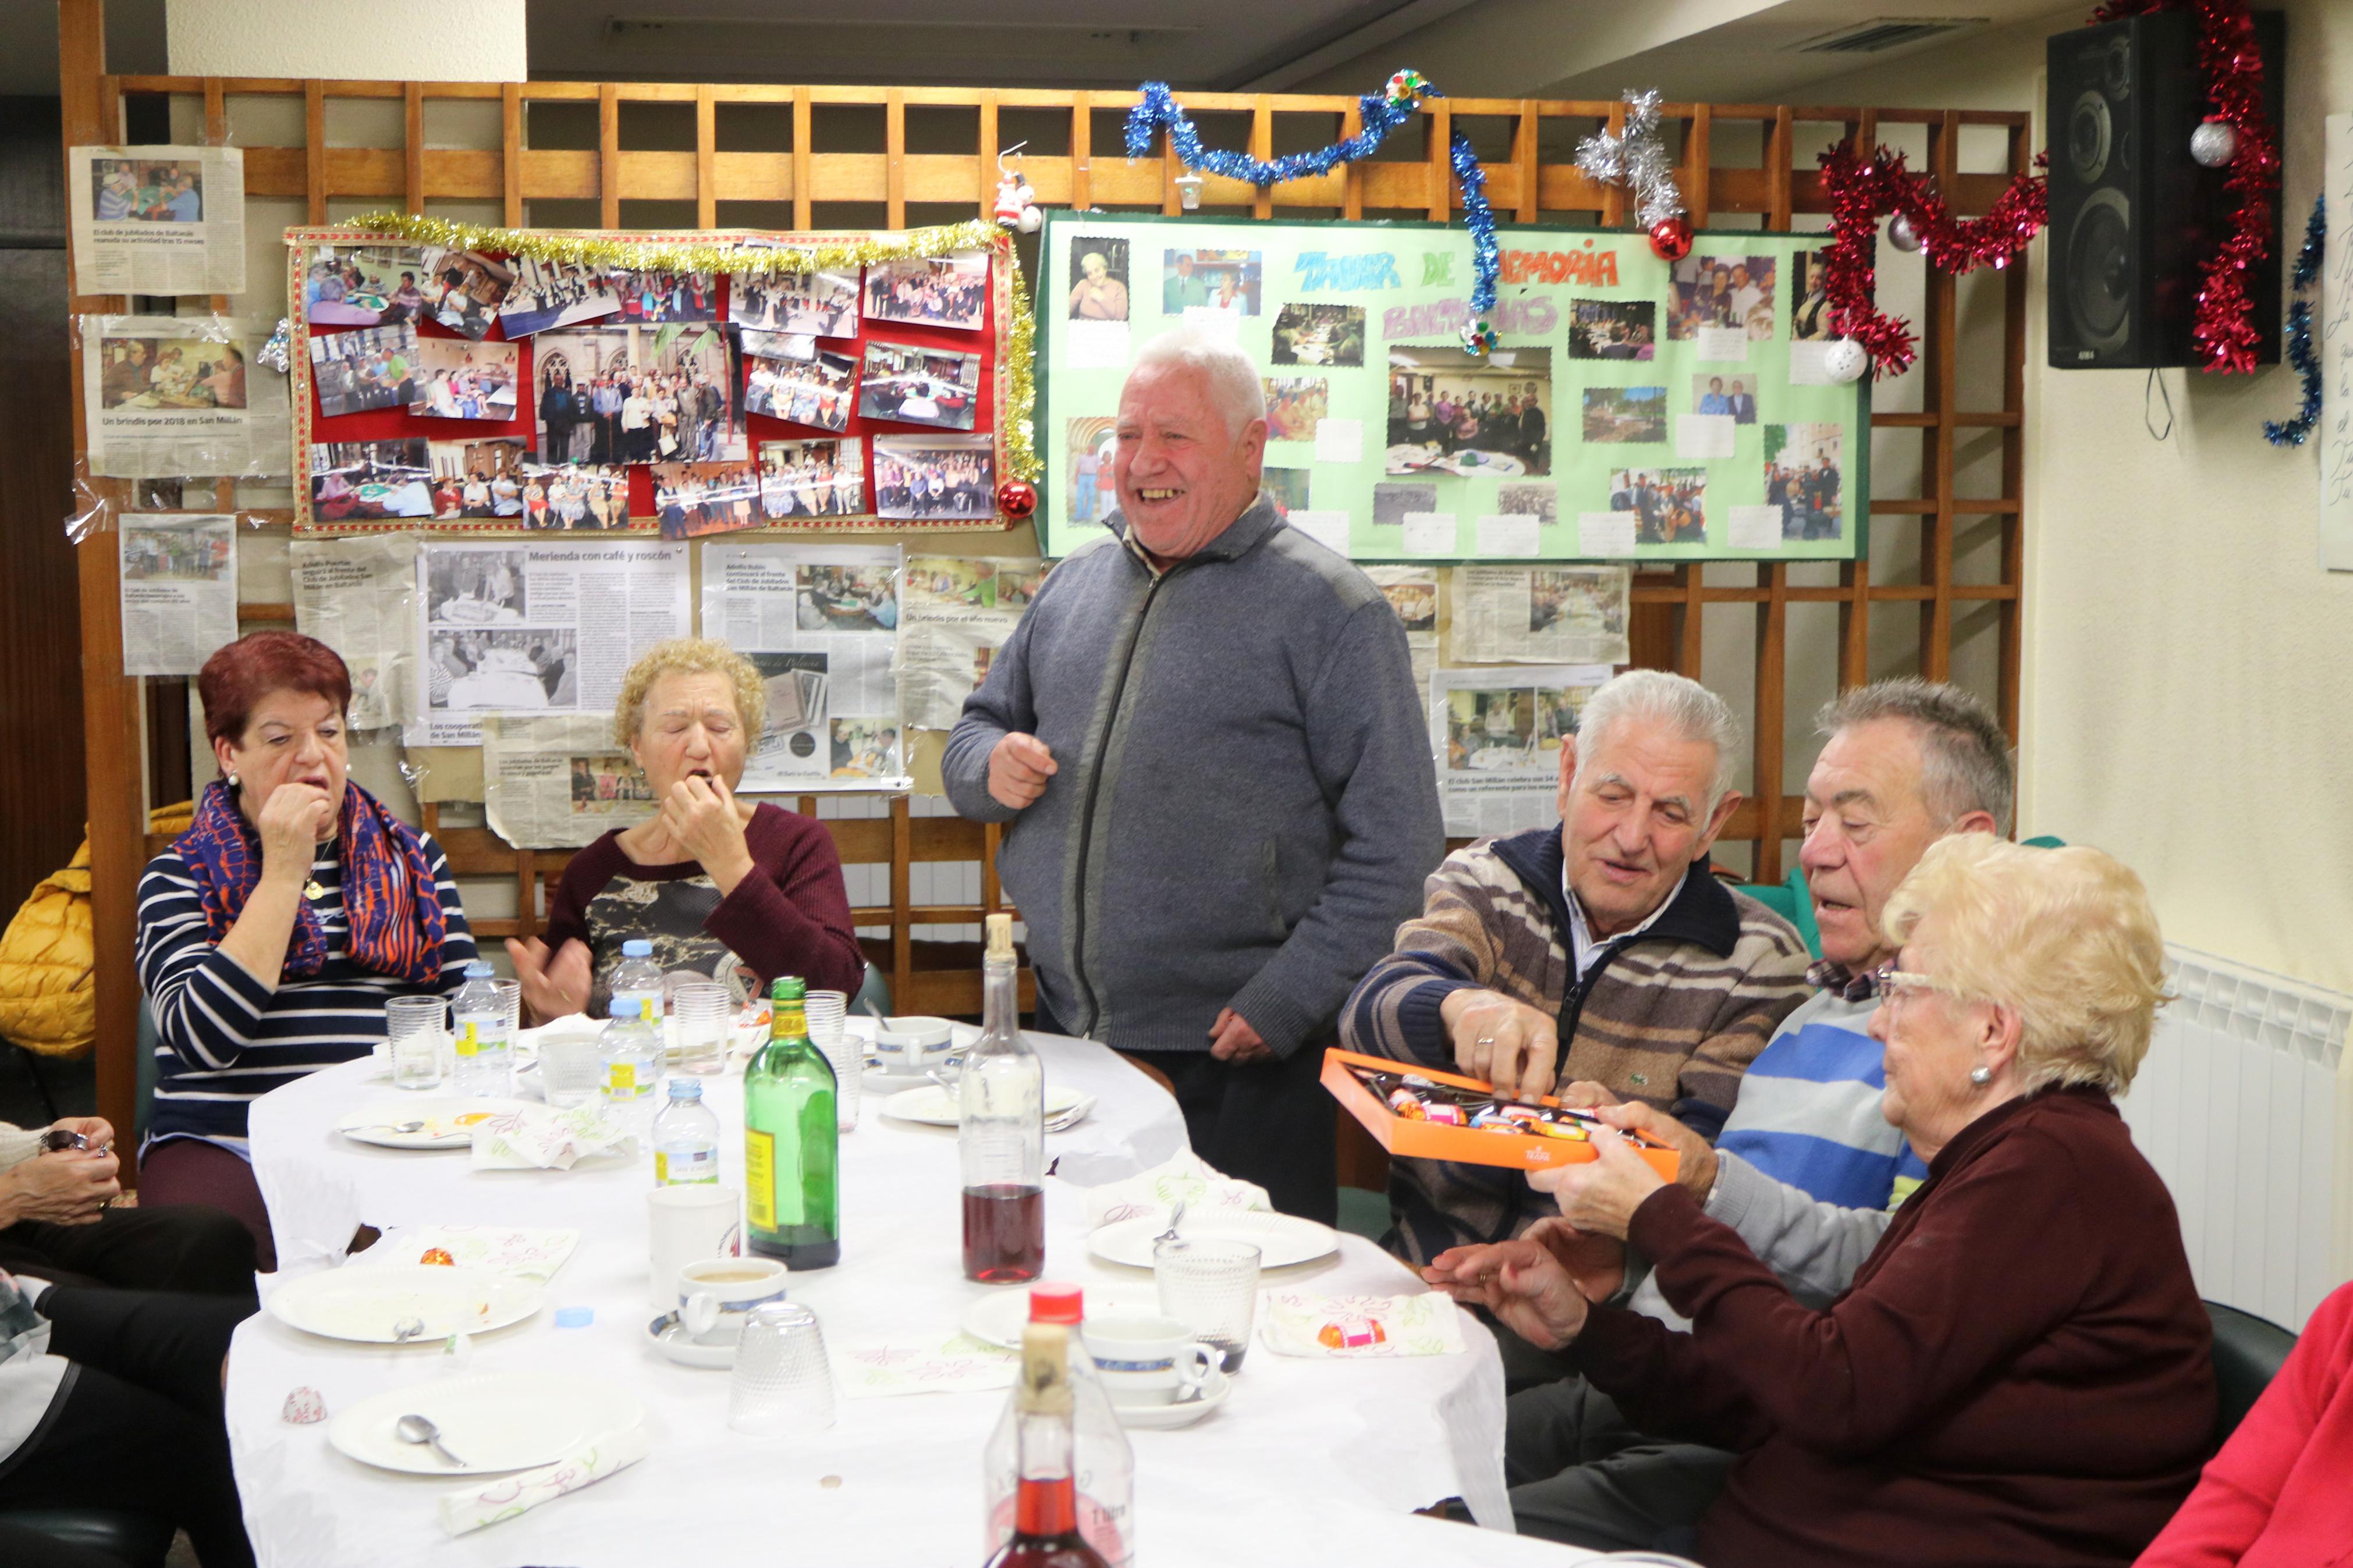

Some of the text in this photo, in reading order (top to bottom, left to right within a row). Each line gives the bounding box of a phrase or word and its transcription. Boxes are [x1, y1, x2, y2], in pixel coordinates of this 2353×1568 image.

[1421, 251, 1456, 287] DE
[117, 417, 145, 425] brindis
[147, 418, 162, 426] por
[199, 417, 214, 425] San
[529, 550, 672, 563] Merienda con café y roscón
[906, 613, 917, 621] Un
[918, 613, 944, 622] brindis
[946, 615, 960, 623] por
[1525, 1150, 1551, 1162] TRAPA
